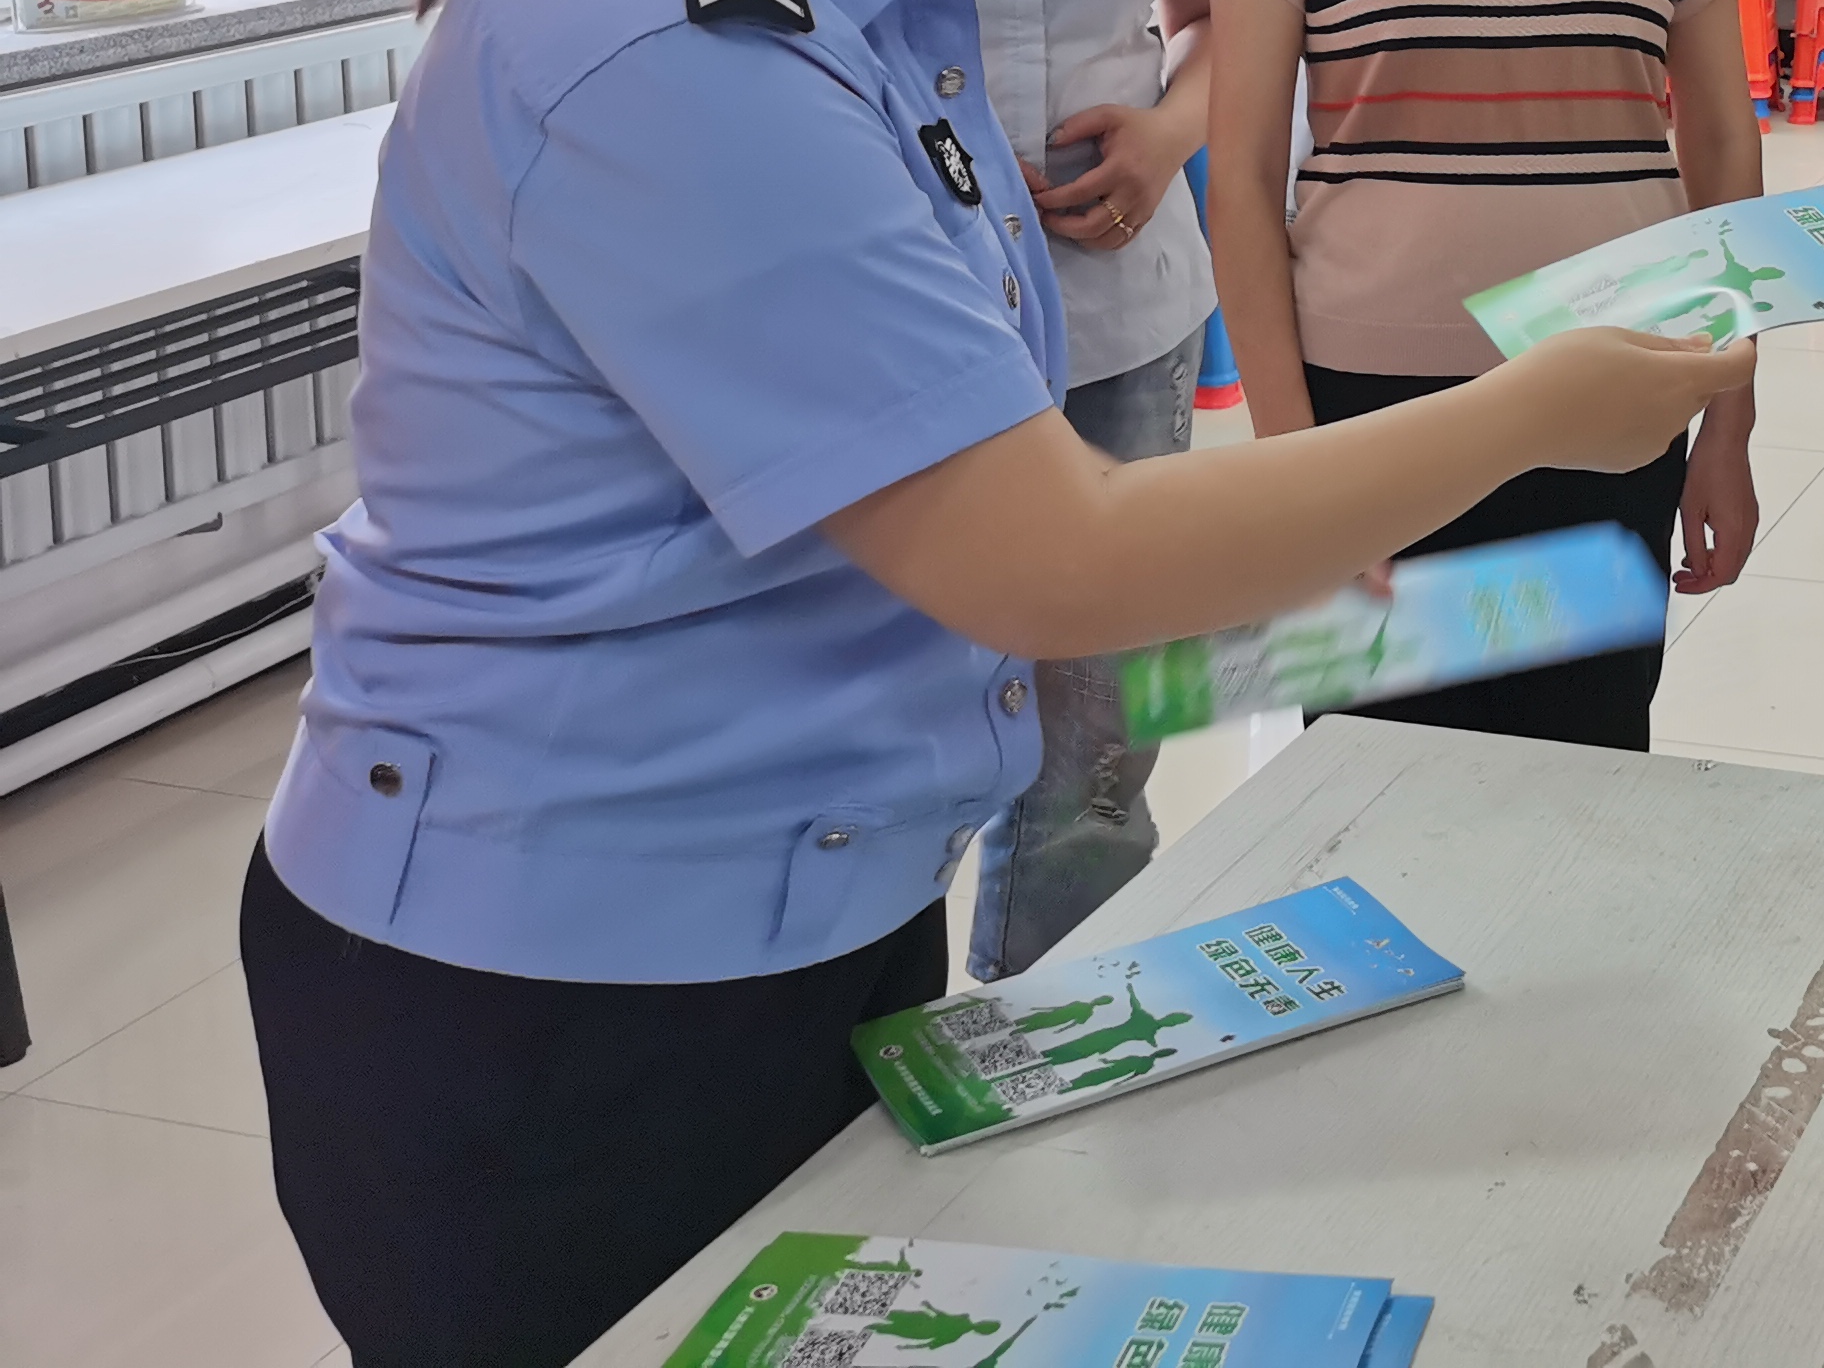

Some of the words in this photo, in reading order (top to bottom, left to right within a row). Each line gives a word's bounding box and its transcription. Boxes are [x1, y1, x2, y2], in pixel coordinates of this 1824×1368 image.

[1197, 938, 1302, 1017] 绿色无毒
[1243, 923, 1347, 1002] 健康人生
